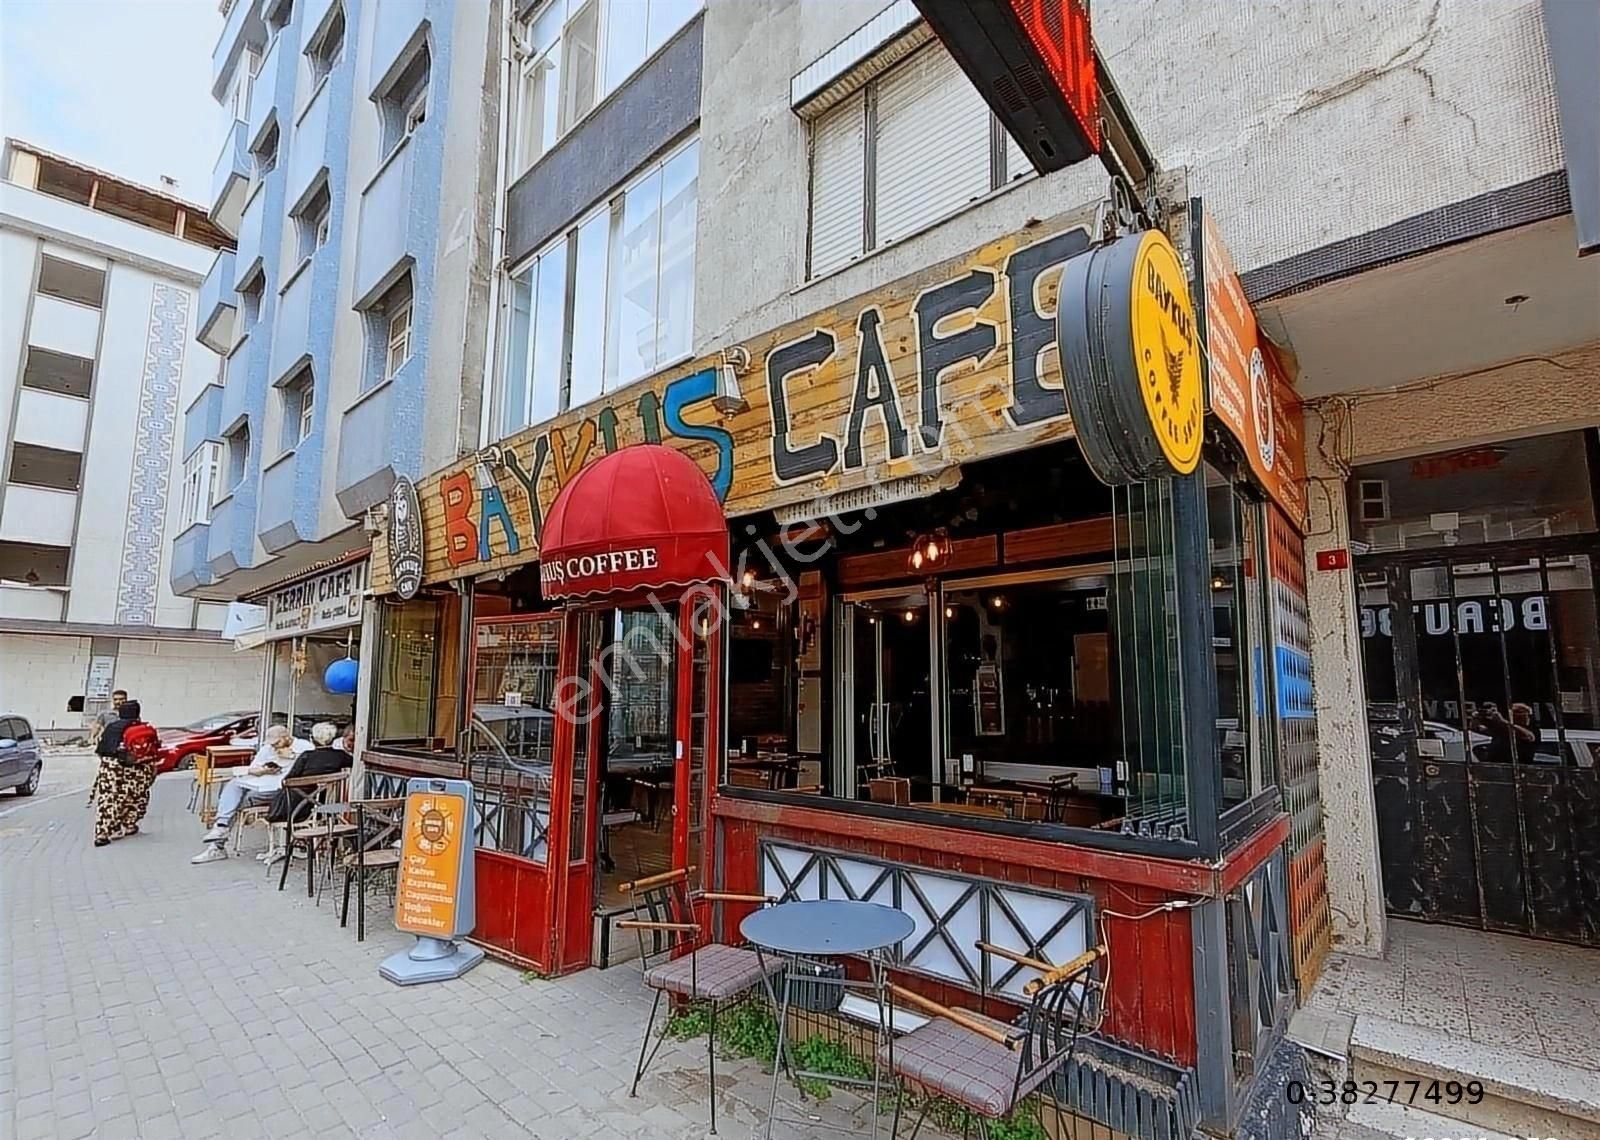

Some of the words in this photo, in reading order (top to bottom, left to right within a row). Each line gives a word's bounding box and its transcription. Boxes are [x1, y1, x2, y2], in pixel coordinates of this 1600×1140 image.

[764, 225, 1096, 486] CAFE
[566, 548, 659, 578] COFFEE
[1328, 555, 1337, 565] 3
[318, 569, 352, 602] CAFE
